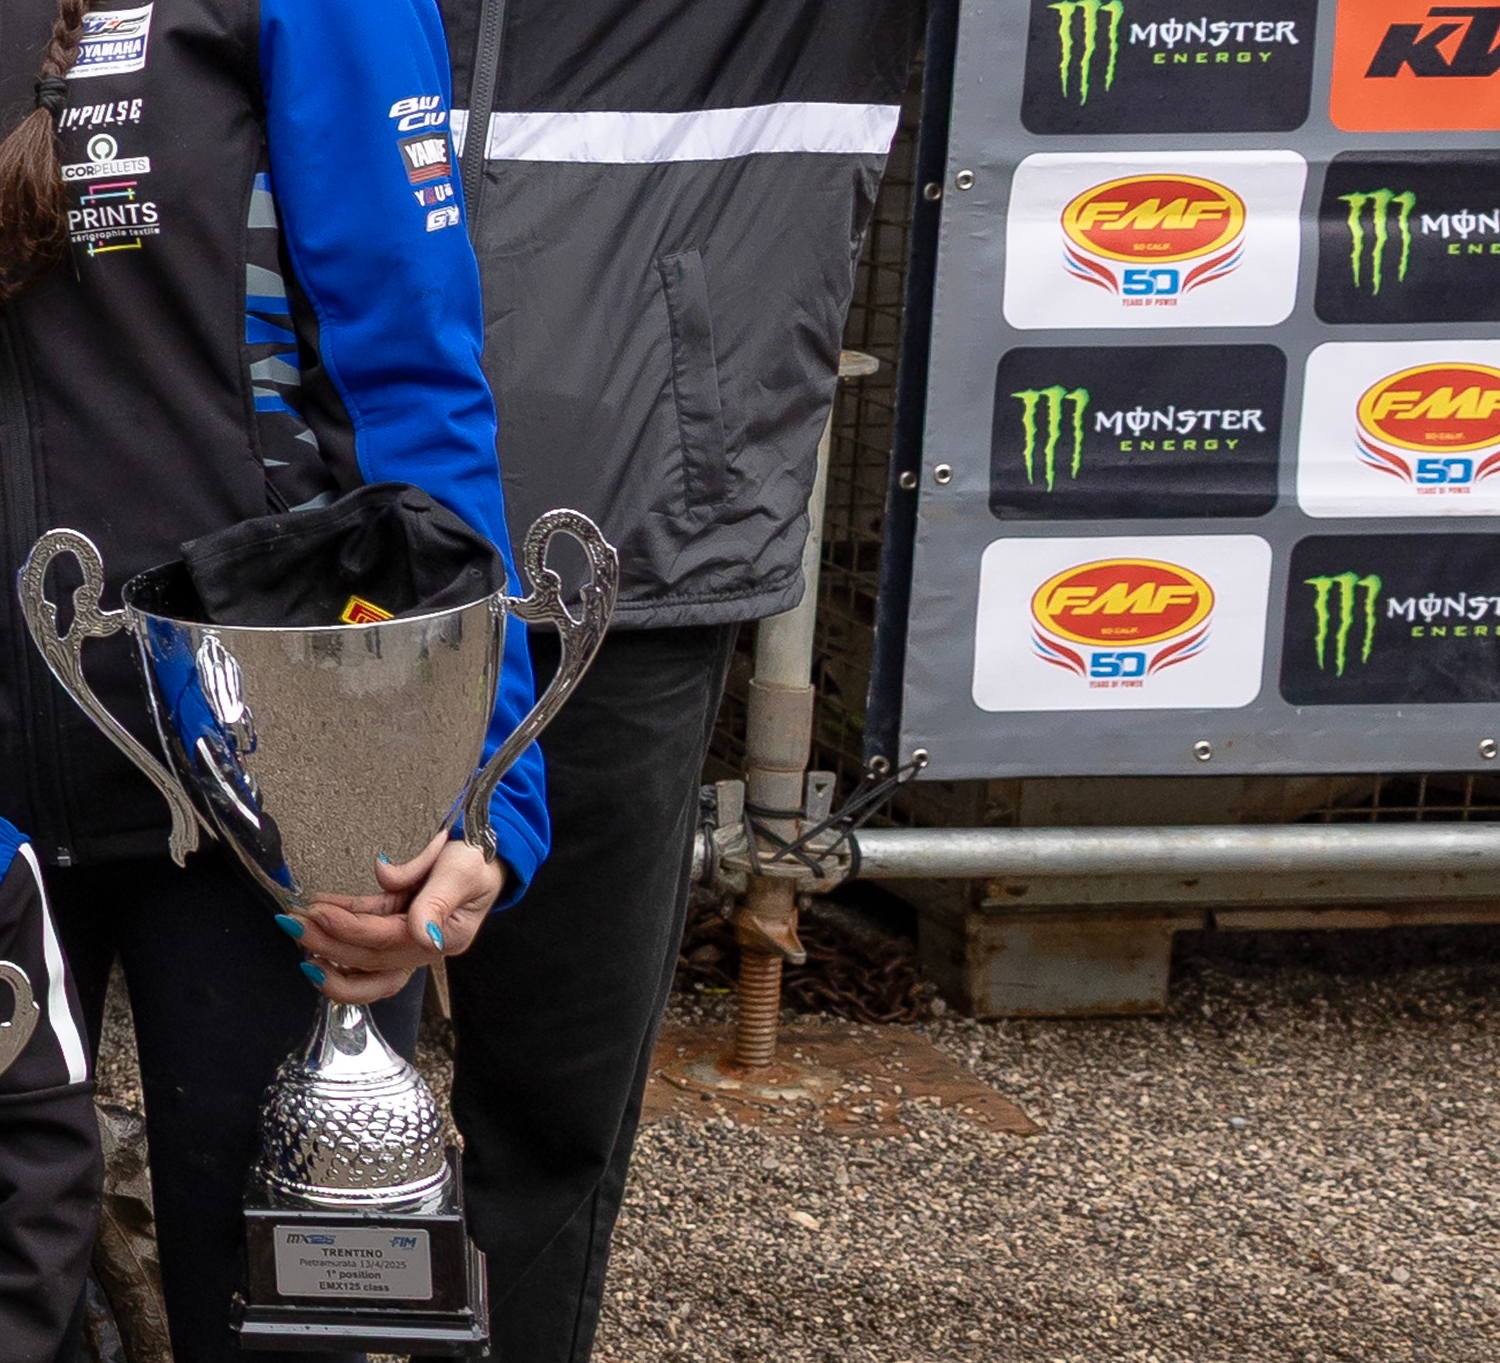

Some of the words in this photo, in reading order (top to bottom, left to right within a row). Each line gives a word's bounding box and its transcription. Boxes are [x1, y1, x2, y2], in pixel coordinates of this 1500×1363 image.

[1130, 18, 1300, 49] MONSTER
[1364, 6, 1500, 78] KT
[84, 39, 142, 57] YAMAHA
[1153, 52, 1273, 64] ENERGY
[59, 98, 143, 128] IMPULSE
[65, 159, 147, 178] CORPELLETS
[67, 202, 158, 231] PRINTS
[1077, 197, 1230, 231] FMF
[1122, 268, 1180, 296] 50
[1094, 405, 1266, 436] MONSTER
[1120, 439, 1239, 453] ENERGY
[1416, 458, 1473, 484] 50
[1048, 582, 1198, 616] FMF
[1090, 652, 1146, 678] 50
[300, 1258, 357, 1268] Pietramurata
[360, 1260, 407, 1269] 13/4/2025
[321, 1247, 383, 1258] TRENTINO
[319, 1281, 361, 1291] EMX125
[363, 1282, 390, 1292] class
[339, 1270, 381, 1279] position
